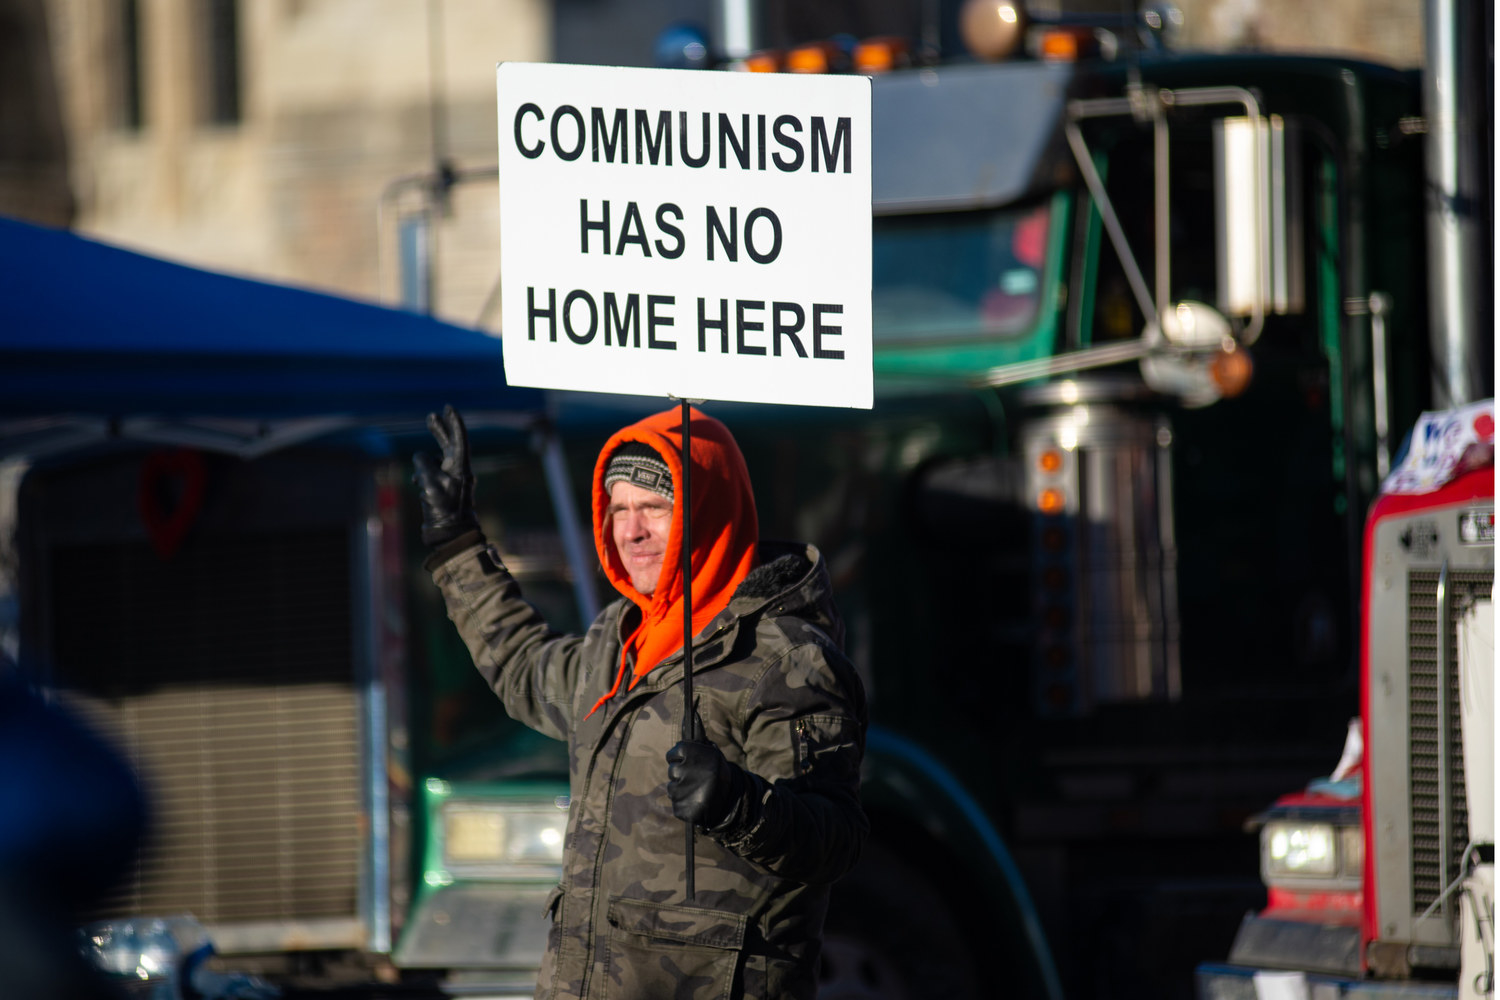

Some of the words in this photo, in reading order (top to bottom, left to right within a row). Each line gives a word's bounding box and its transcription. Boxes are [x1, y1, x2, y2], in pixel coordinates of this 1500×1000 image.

[513, 102, 852, 174] COMMUNISM
[580, 198, 686, 260] HAS
[706, 205, 783, 265] NO
[527, 286, 677, 351] HOME
[697, 297, 845, 360] HERE
